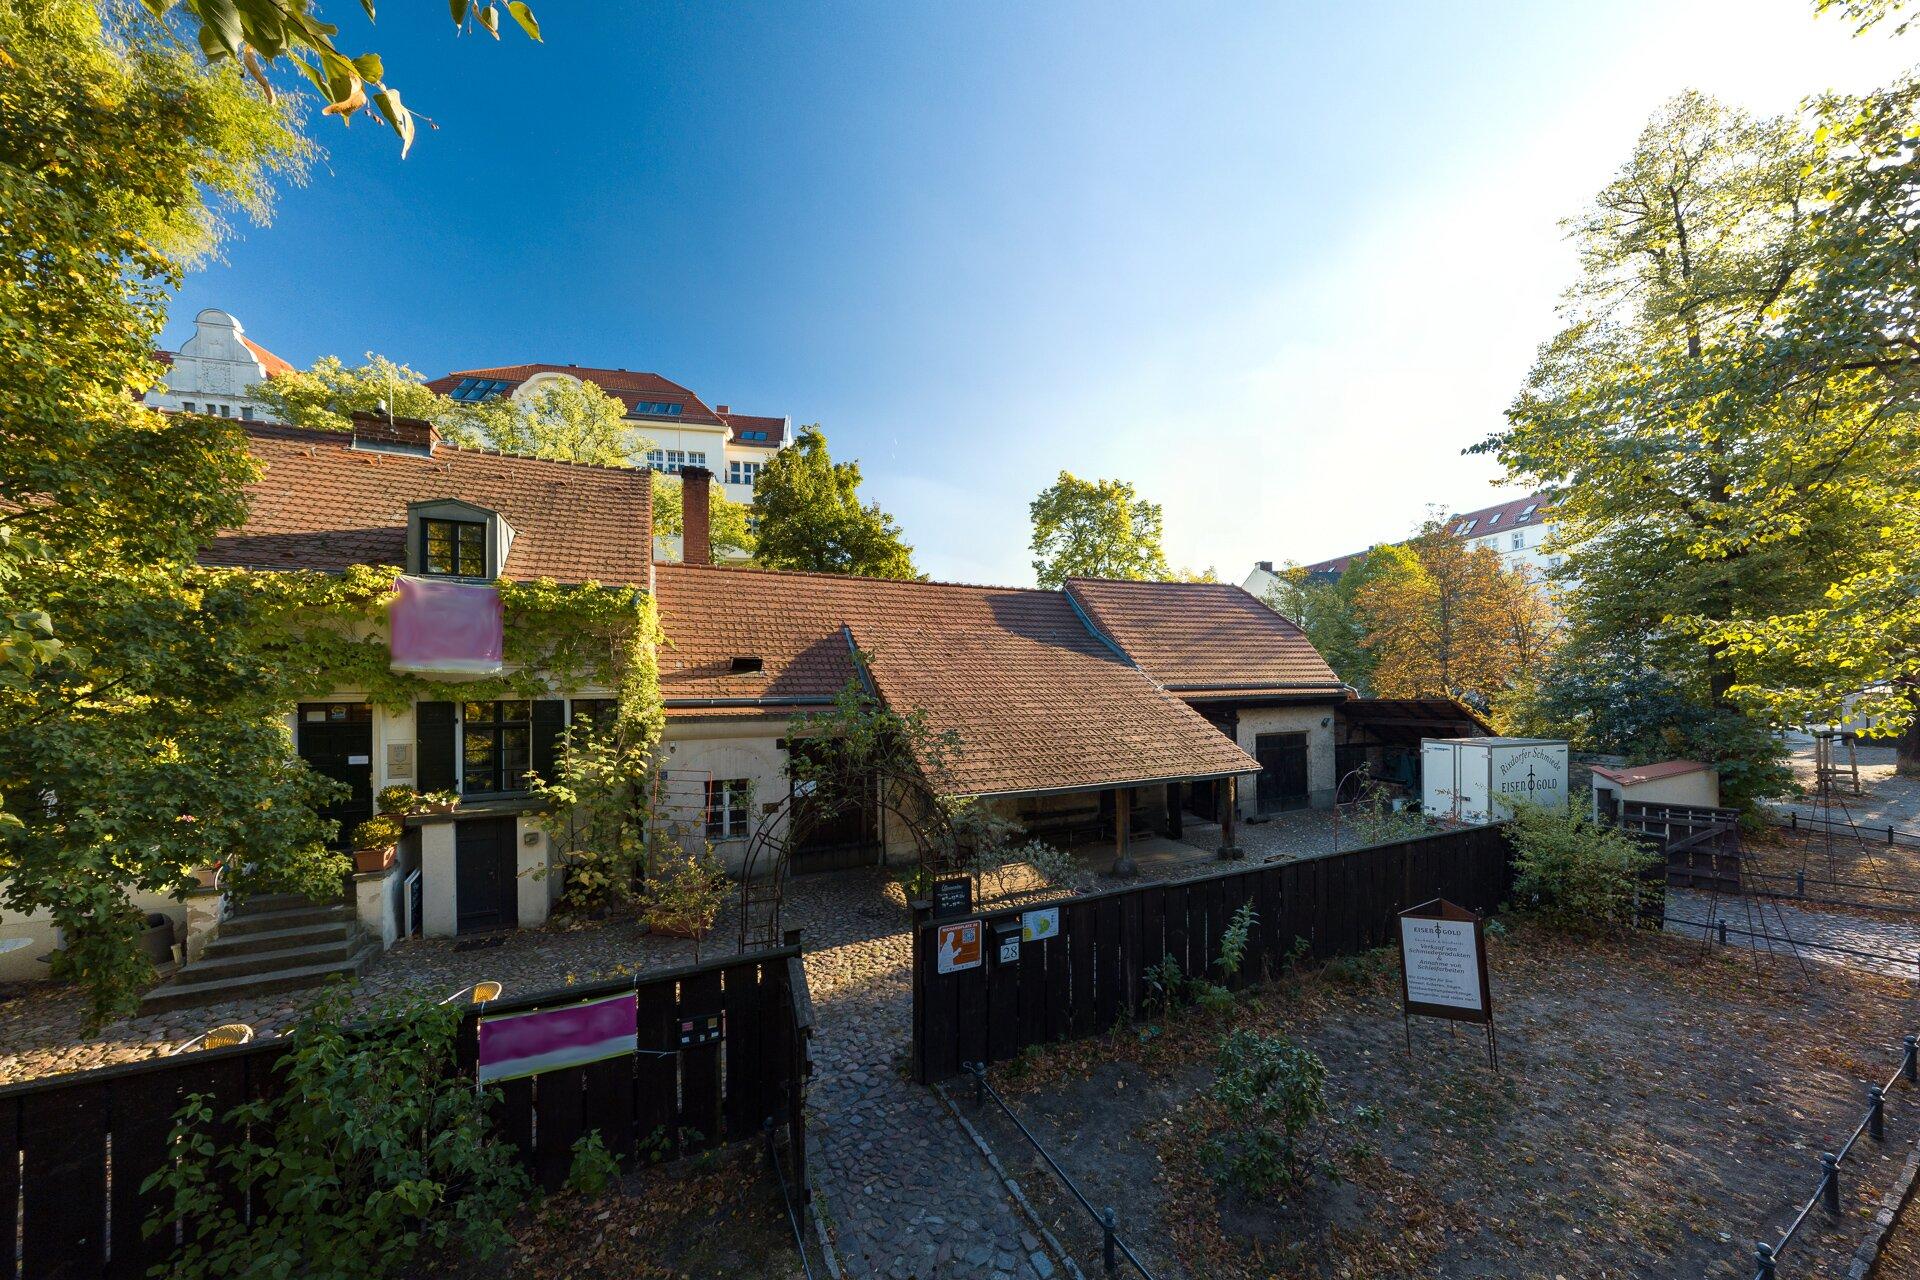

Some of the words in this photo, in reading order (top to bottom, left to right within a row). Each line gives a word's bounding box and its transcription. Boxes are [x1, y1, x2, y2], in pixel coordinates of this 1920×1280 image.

[1500, 748, 1531, 775] Rixdorfer
[1532, 747, 1561, 771] Schmiede
[1536, 779, 1557, 790] GOLD
[1003, 945, 1018, 960] 28
[1408, 948, 1471, 958] Schmiedeprodukten
[1417, 964, 1465, 974] Schleifarbeiten
